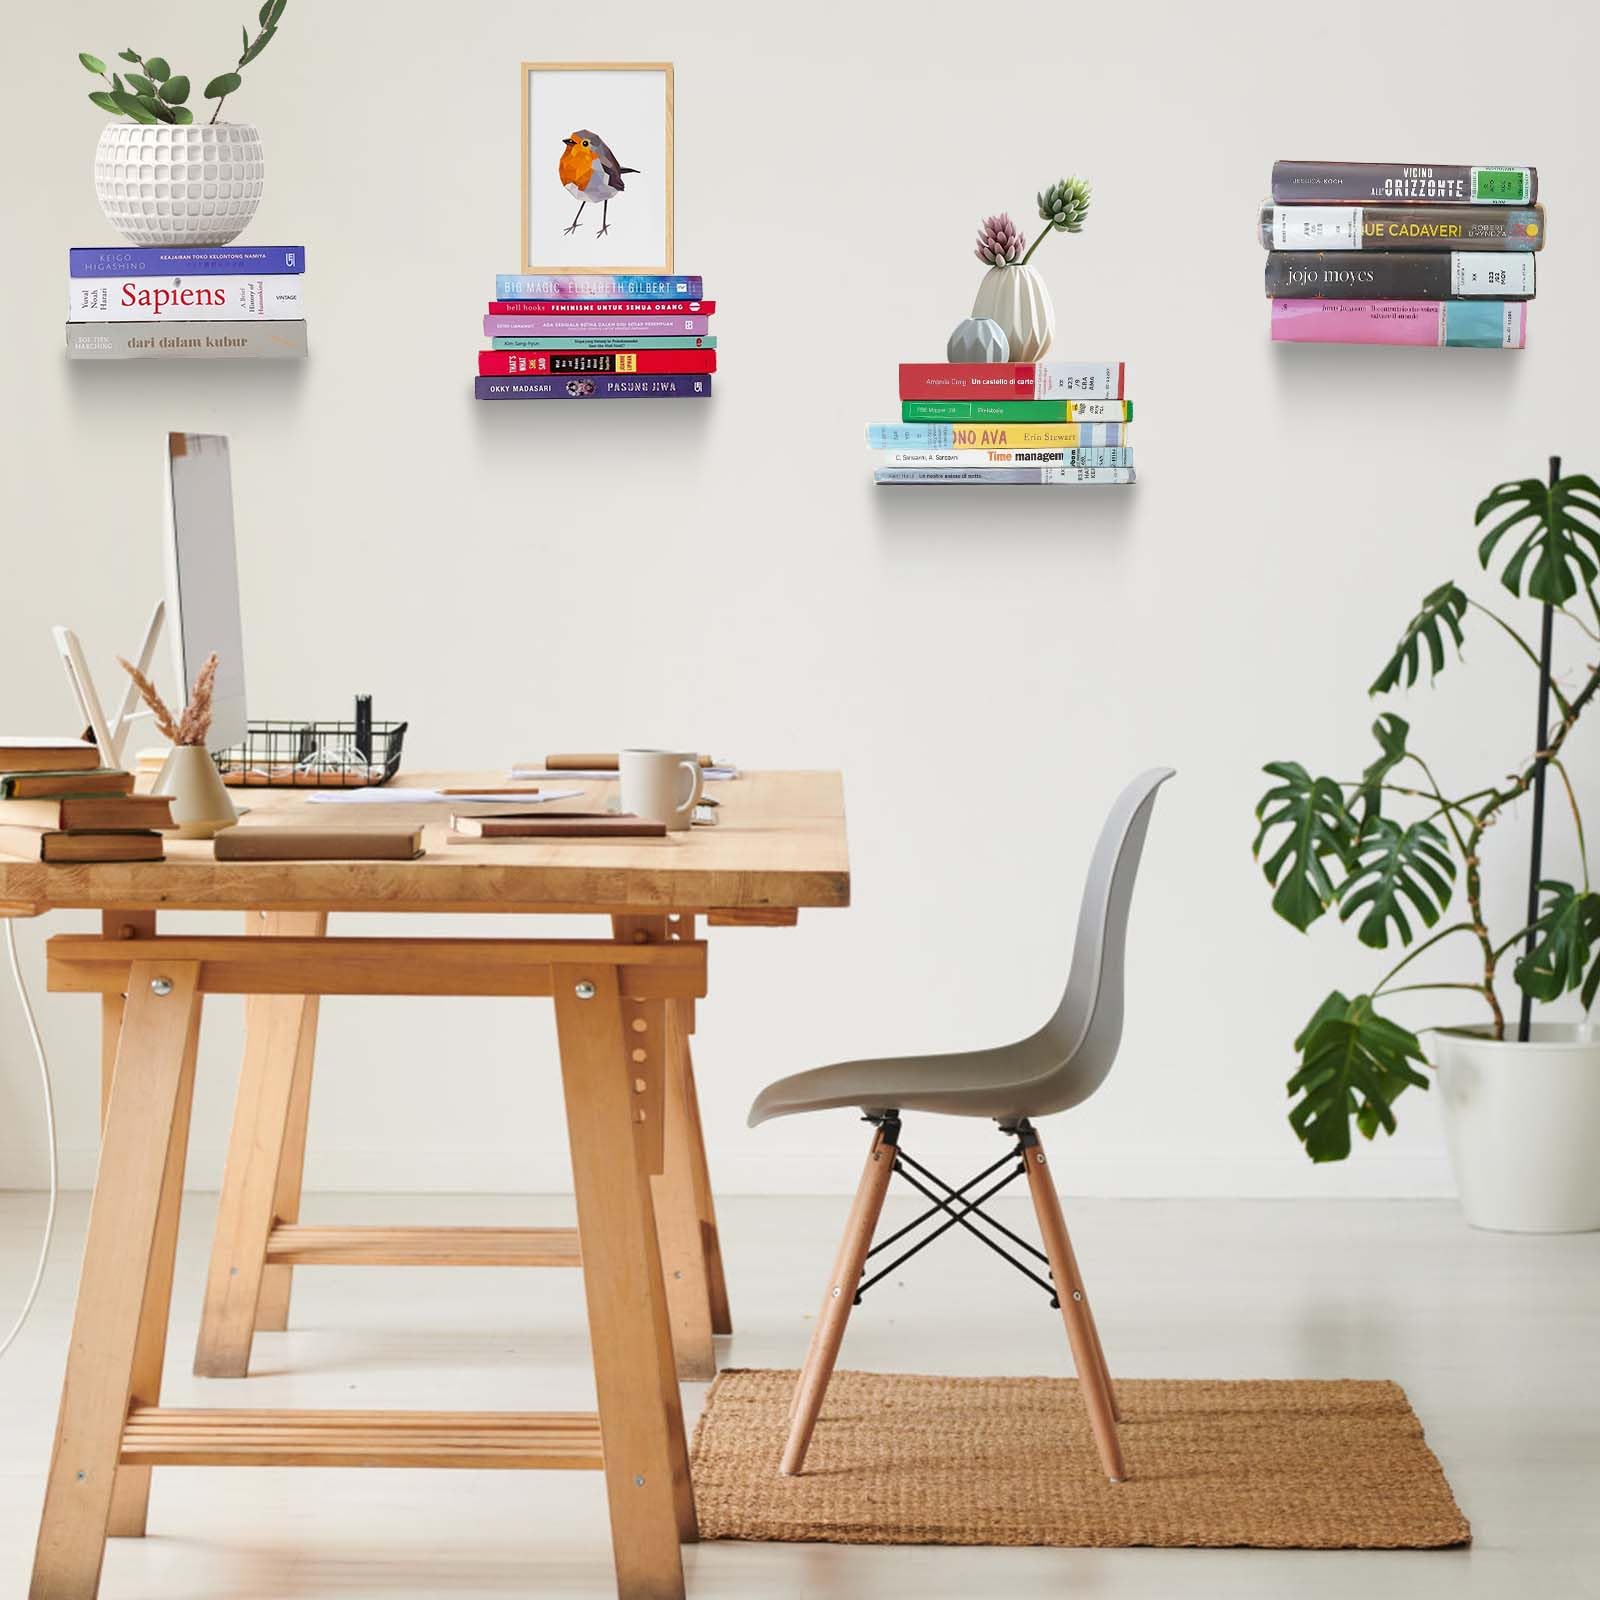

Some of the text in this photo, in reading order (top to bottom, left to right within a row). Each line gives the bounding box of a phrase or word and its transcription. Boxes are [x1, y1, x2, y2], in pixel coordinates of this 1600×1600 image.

[1403, 168, 1433, 178] VICINO
[1389, 224, 1462, 237] CADAVERI
[84, 262, 146, 271] HIGASHINO
[1286, 265, 1375, 287] jojo moyes
[504, 282, 522, 293] BIG
[526, 282, 560, 293] MAGIC
[628, 282, 672, 294] GILBERT
[81, 290, 89, 308] Yuval
[90, 290, 98, 309] Noah
[121, 282, 226, 315] Sapiens
[127, 336, 248, 349] dari dalam kubur
[509, 355, 517, 373] THAT'S
[519, 357, 527, 372] WHAT
[529, 359, 537, 369] SHE
[538, 357, 546, 370] SAID
[490, 385, 509, 393] OKKY
[607, 382, 677, 392] PASUNG JIWA
[981, 429, 1007, 446] AVA
[1024, 432, 1076, 441] Erin Stewart
[988, 451, 1013, 462] Time
